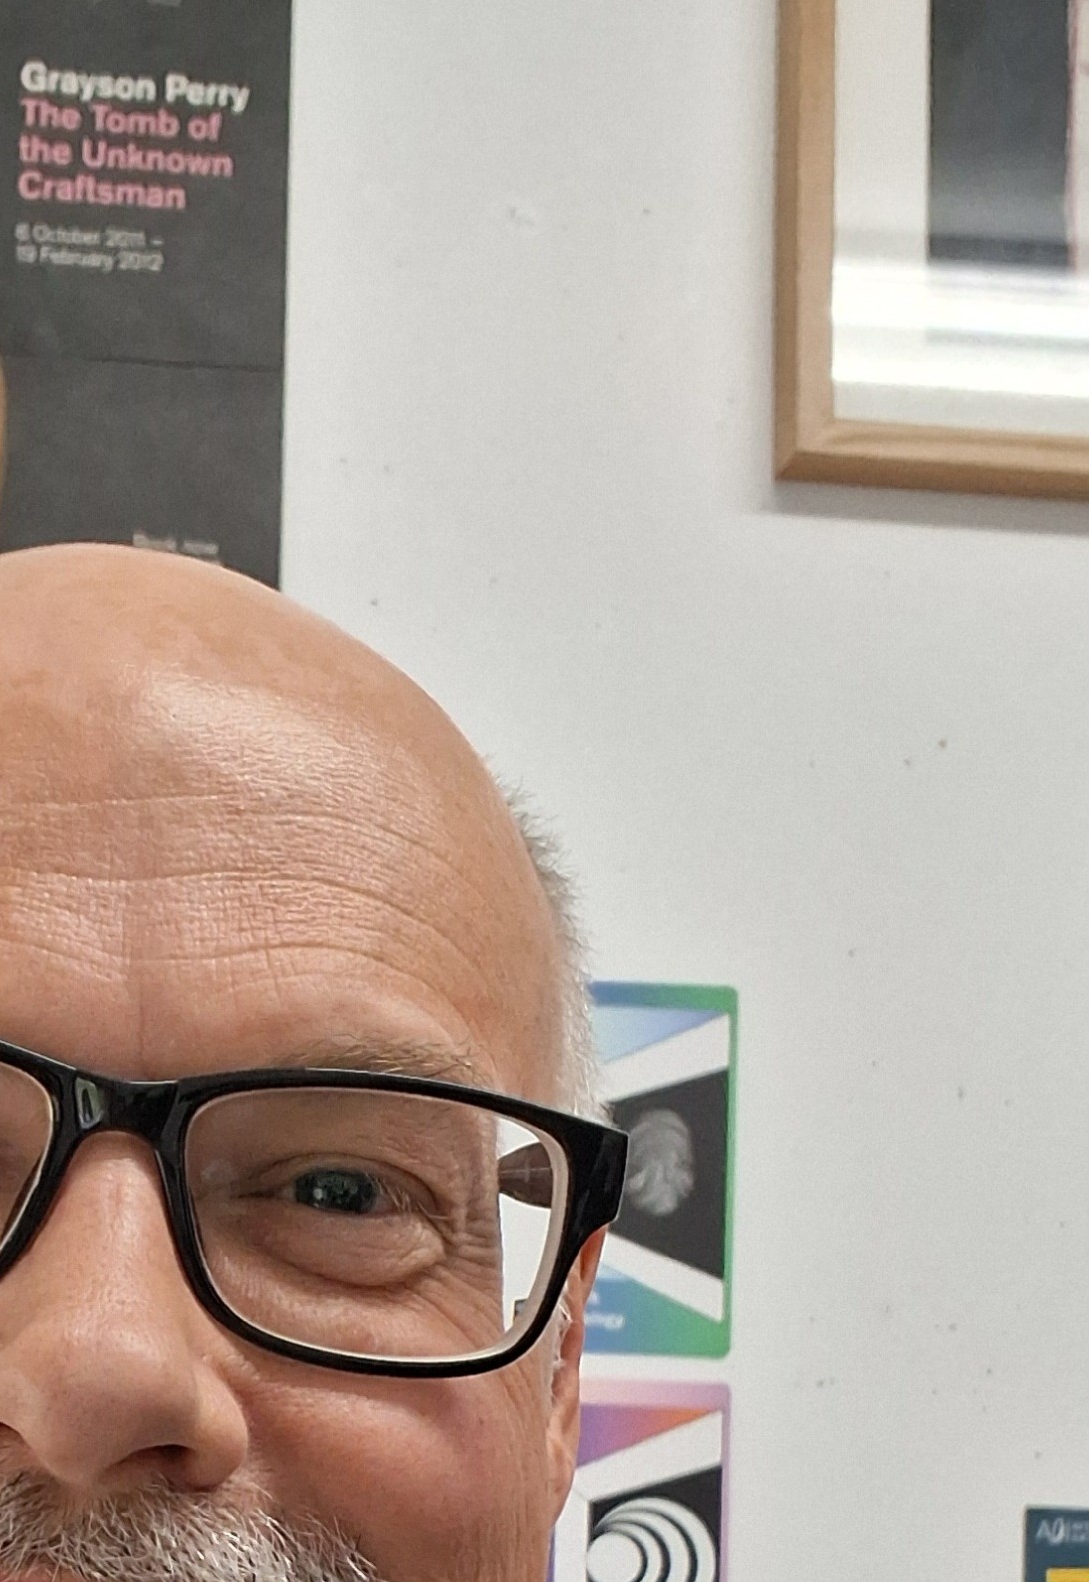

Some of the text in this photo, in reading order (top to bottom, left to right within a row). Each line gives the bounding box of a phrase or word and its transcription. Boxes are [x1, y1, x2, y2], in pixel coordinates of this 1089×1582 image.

[21, 61, 251, 114] Grayson Perry
[21, 97, 222, 143] The Tomb of
[19, 134, 234, 177] the Unknown
[18, 170, 187, 210] Craftsman
[32, 223, 101, 245] October
[39, 246, 114, 273] February
